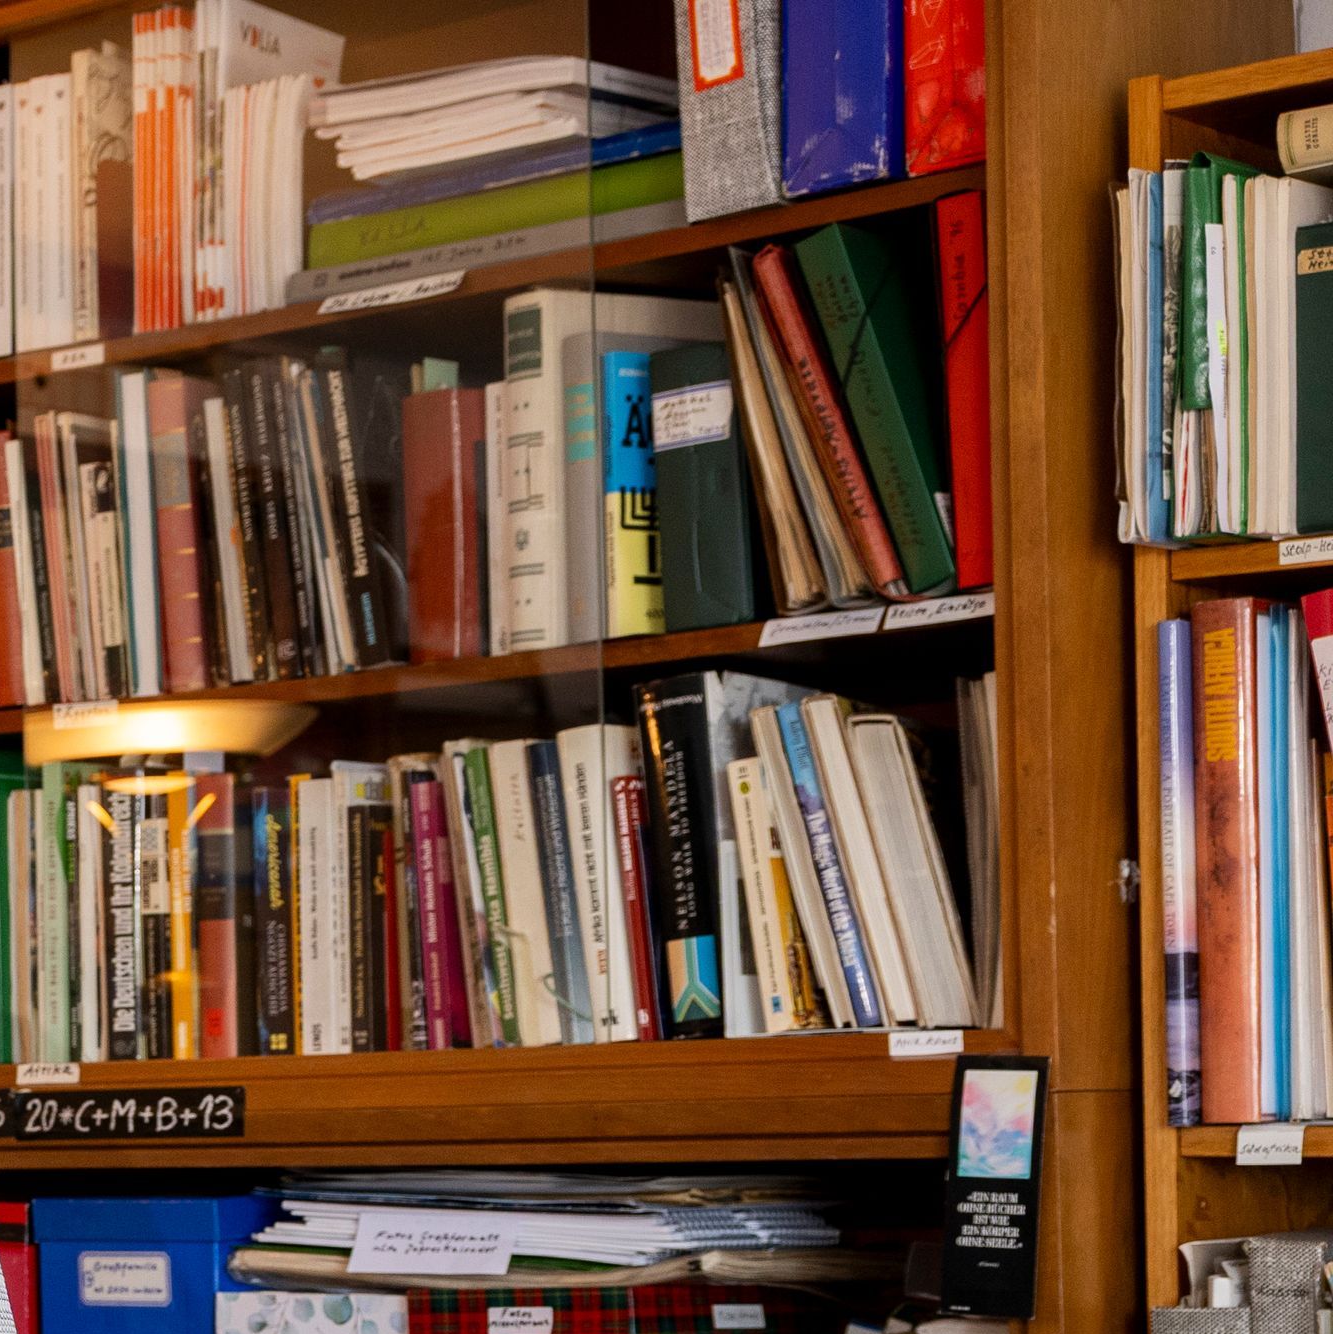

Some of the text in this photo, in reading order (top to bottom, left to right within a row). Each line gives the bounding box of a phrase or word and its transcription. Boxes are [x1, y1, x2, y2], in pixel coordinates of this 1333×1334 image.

[1203, 627, 1236, 762] SOUTH AFRICA
[573, 762, 591, 799] Händen
[672, 750, 690, 811] FREEDOM
[1163, 786, 1173, 848] PORTRAIT
[658, 739, 693, 931] NELSON MANDELA
[266, 815, 285, 910] Americanah
[478, 834, 503, 896] Namibia
[681, 841, 695, 876] WALK
[1164, 854, 1173, 868] OF
[685, 881, 698, 917] LONG
[821, 868, 844, 900] World
[1164, 874, 1175, 907] CAPE
[111, 792, 133, 1031] Die Deutschen und Kolonialreich
[590, 914, 606, 945] Afrika
[1165, 912, 1176, 948] TOWN
[24, 1066, 72, 1076] Afrika
[957, 1203, 1026, 1215] OHNE BÜCHER
[992, 1192, 1018, 1202] RAUM
[961, 1226, 1020, 1237] EIN KÖRPER
[973, 1216, 1009, 1226] IST WIE
[956, 1237, 984, 1247] OHNE
